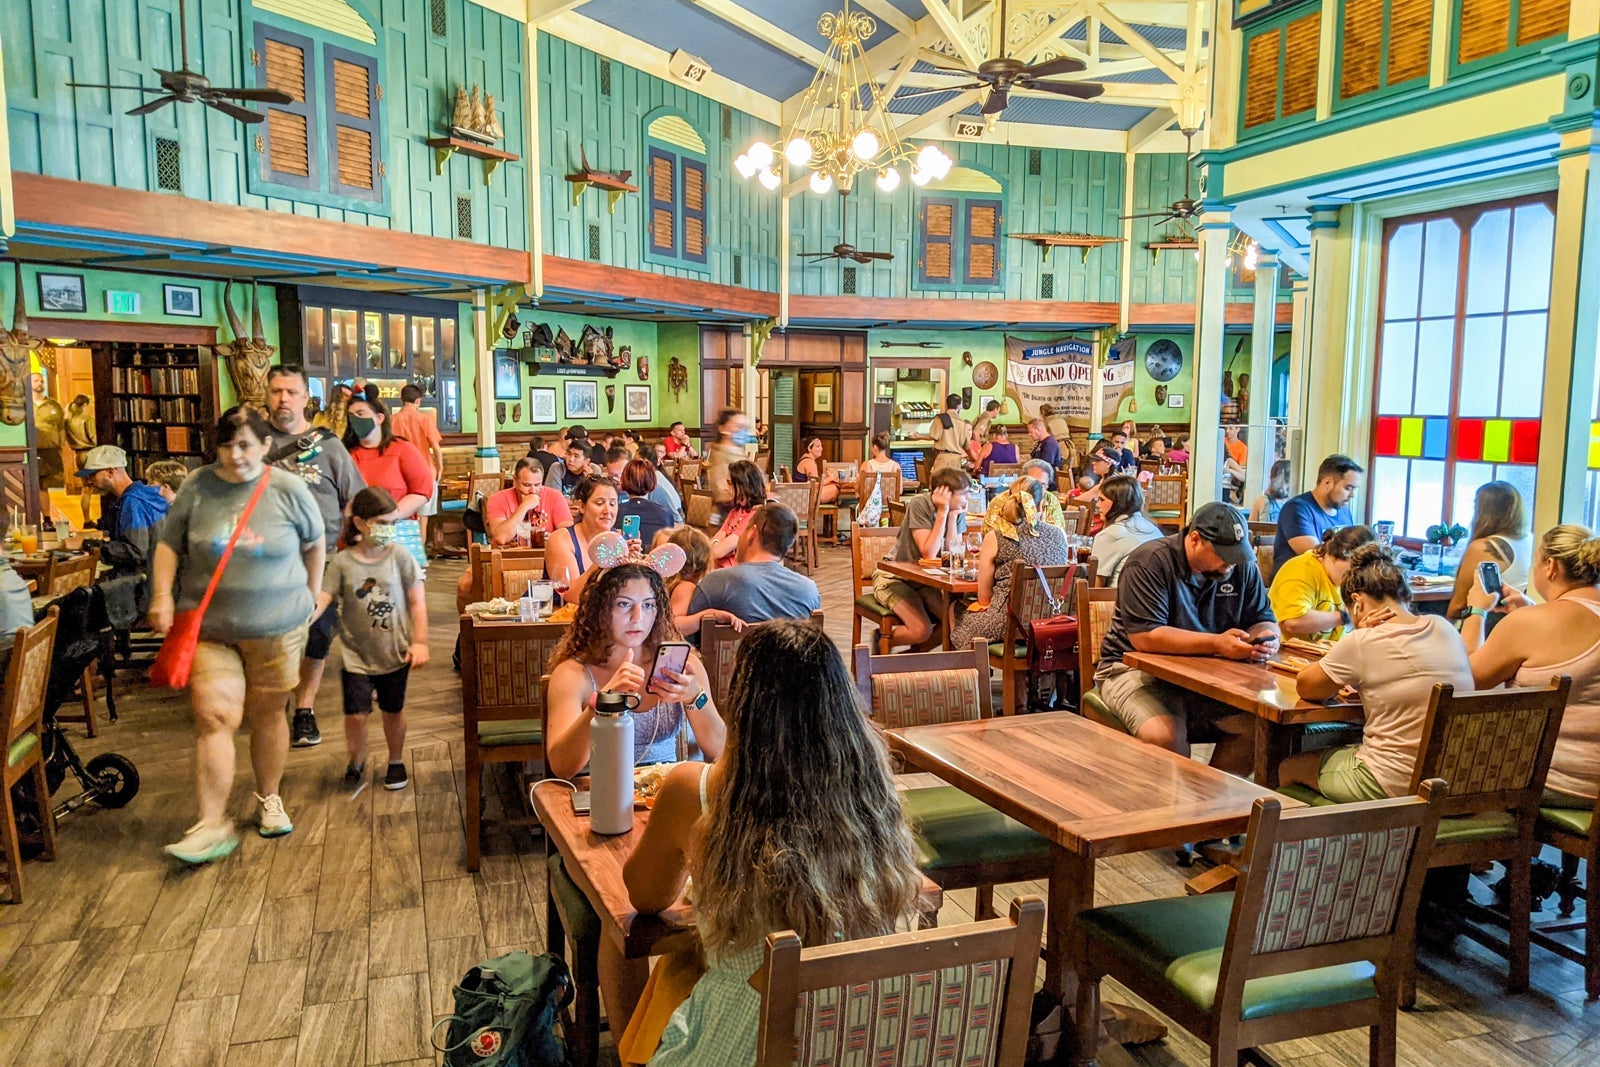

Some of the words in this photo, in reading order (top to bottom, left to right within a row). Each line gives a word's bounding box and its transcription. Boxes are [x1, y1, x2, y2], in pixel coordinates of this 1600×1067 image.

[113, 291, 134, 312] EXIT
[1031, 348, 1054, 356] JUNGLE
[1055, 344, 1090, 353] NAVIGATION
[1027, 366, 1065, 385] GRAND
[1068, 363, 1114, 381] OPENG
